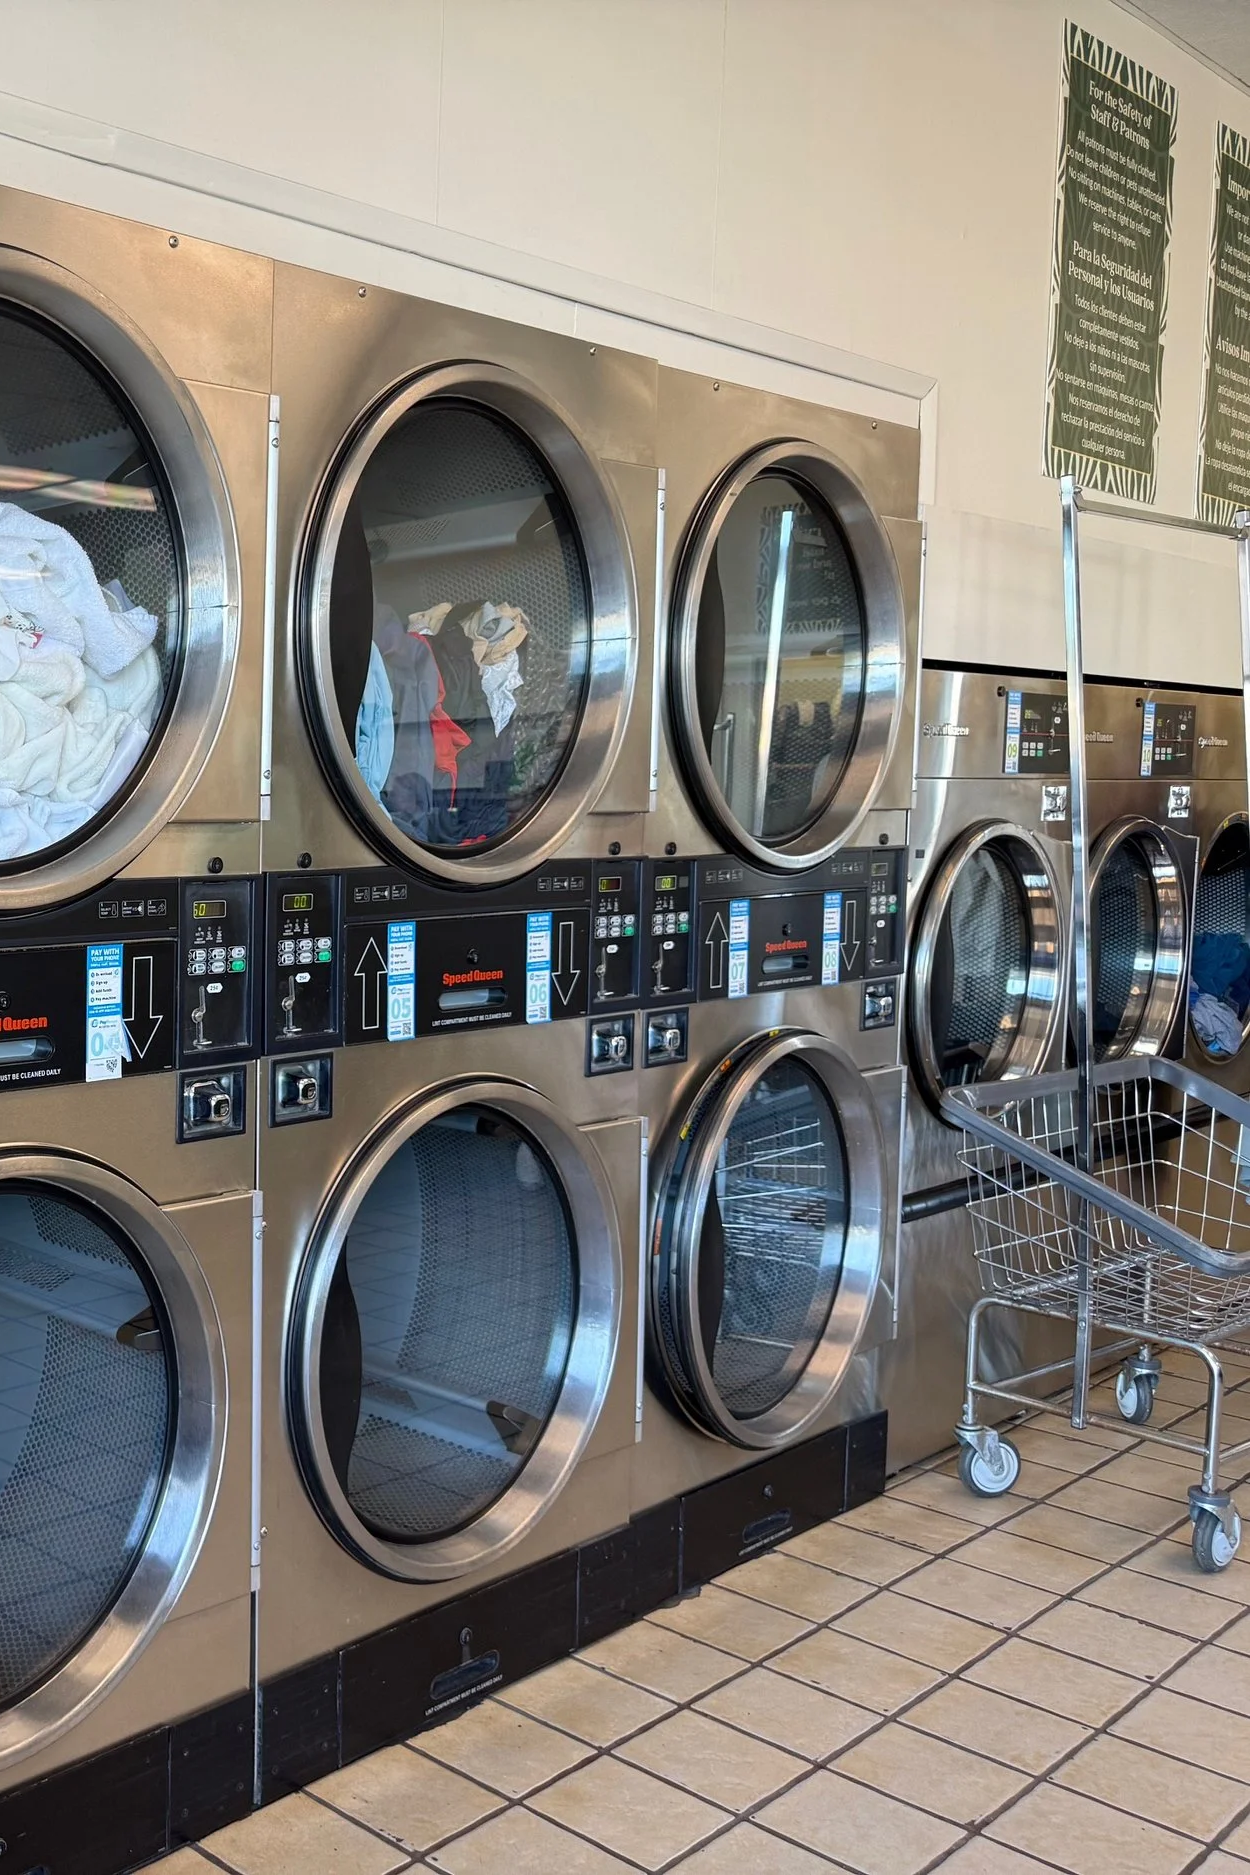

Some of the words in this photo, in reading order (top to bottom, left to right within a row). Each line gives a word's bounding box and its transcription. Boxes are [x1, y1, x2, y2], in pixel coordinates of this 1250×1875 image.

[1089, 80, 1104, 101] For
[1105, 90, 1118, 109] the
[1118, 98, 1143, 127] Safety
[1143, 114, 1152, 129] of
[1091, 104, 1111, 128] Staff
[1111, 116, 1119, 132] &
[1120, 120, 1150, 150] Patrons
[1077, 130, 1086, 143] All
[1085, 136, 1105, 154] patrons
[1106, 147, 1119, 162] must
[1119, 152, 1126, 166] be
[1127, 156, 1138, 173] fully
[1066, 144, 1075, 158] Do
[1074, 151, 1084, 164] not
[1085, 154, 1099, 171] leave
[1099, 162, 1120, 182] children
[1120, 174, 1126, 185] or
[1126, 179, 1138, 192] pets
[1069, 166, 1077, 179] No
[1077, 170, 1093, 191] sitting
[1094, 182, 1101, 191] on
[1101, 184, 1126, 206] machines,
[1143, 207, 1149, 217] or
[1078, 191, 1088, 206] We
[1088, 198, 1107, 216] reserve
[1108, 206, 1117, 220] the
[1117, 212, 1129, 227] right
[1129, 218, 1135, 230] to
[1135, 222, 1151, 238] refuse
[1092, 221, 1110, 238] service
[1111, 228, 1117, 240] to
[1073, 240, 1092, 263] Para
[1093, 249, 1100, 267] la
[1101, 253, 1140, 285] Seguridad
[1140, 272, 1152, 290] del
[1220, 258, 1227, 271] Do
[1227, 264, 1235, 276] not
[1235, 265, 1247, 282] leave
[1068, 260, 1103, 289] Personal
[1104, 279, 1109, 295] y
[1110, 278, 1121, 297] los
[1122, 284, 1155, 312] Usuarios
[1075, 293, 1090, 311] Todos
[1091, 300, 1099, 314] los
[1099, 305, 1118, 322] clientes
[1118, 312, 1134, 329] deben
[1134, 321, 1147, 334] estar
[1079, 319, 1119, 342] completamente
[1064, 330, 1072, 344] No
[1072, 334, 1085, 349] deje
[1085, 341, 1089, 350] a
[1089, 339, 1097, 353] los
[1097, 344, 1111, 359] niños
[1111, 349, 1117, 360] ni
[1117, 352, 1120, 362] a
[1128, 357, 1150, 374] mascotas
[1215, 334, 1240, 358] Avisos
[1089, 360, 1097, 373] sin
[1056, 367, 1064, 381] No
[1064, 373, 1086, 389] sentarse
[1086, 381, 1093, 390] en
[1119, 392, 1135, 406] mesas
[1135, 399, 1139, 407] o
[1068, 393, 1079, 406] Nos
[1079, 398, 1108, 416] reservamos
[1108, 406, 1114, 417] el
[1114, 408, 1133, 424] derecho
[1133, 415, 1141, 426] de
[1061, 412, 1083, 427] rechazar
[1083, 417, 1089, 429] la
[1115, 427, 1123, 439] del
[1123, 432, 1142, 446] servicio
[1141, 438, 1145, 447] a
[1081, 438, 1105, 453] cualquier
[1007, 743, 1017, 758] 09
[442, 970, 473, 986] Speed
[474, 969, 503, 981] Queen
[731, 962, 745, 980] 07
[530, 983, 547, 1004] 06
[391, 997, 411, 1020] 05
[2, 1016, 48, 1031] Queen
[20, 1070, 46, 1079] CLEANED
[46, 1068, 61, 1076] DAILY
